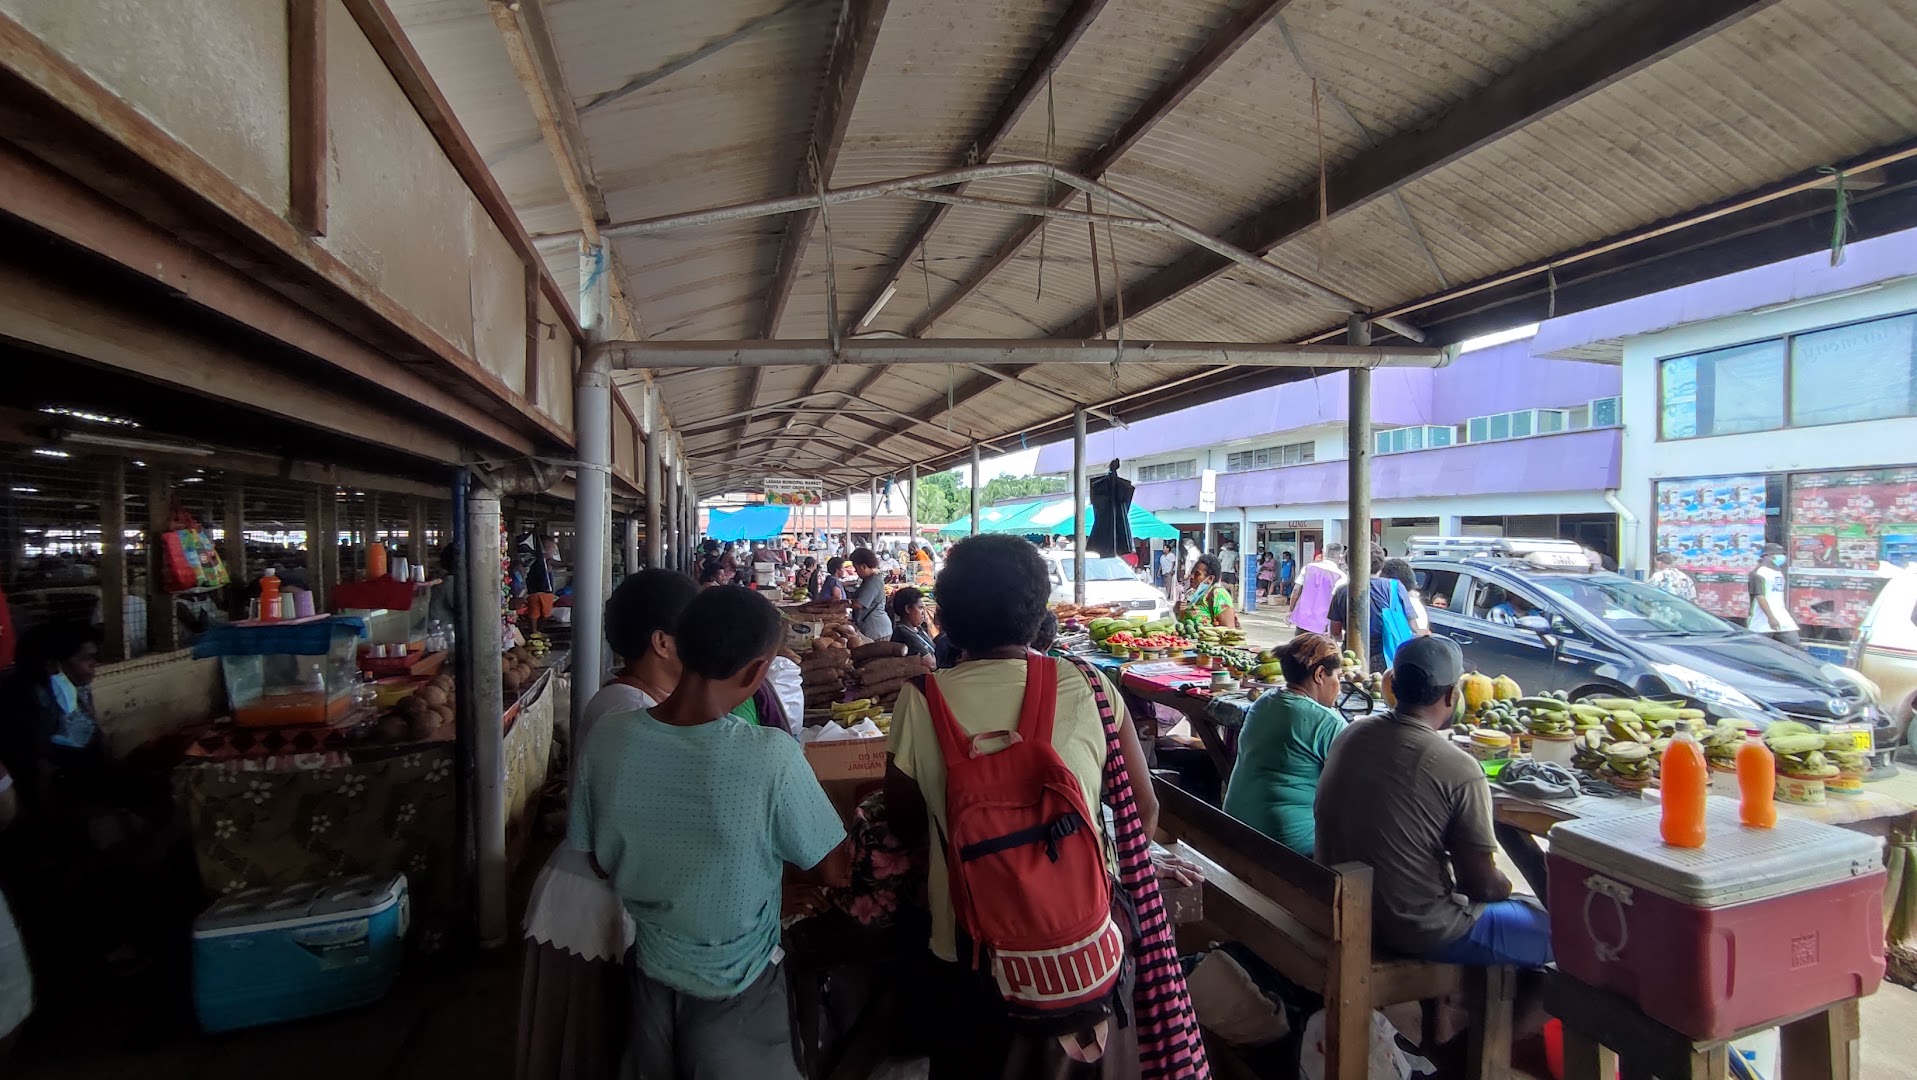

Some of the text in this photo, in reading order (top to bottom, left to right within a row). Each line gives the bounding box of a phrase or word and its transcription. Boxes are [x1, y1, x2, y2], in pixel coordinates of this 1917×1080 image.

[858, 751, 887, 761] DO NO
[848, 761, 882, 771] JANGAN
[1001, 925, 1121, 996] PUMA
